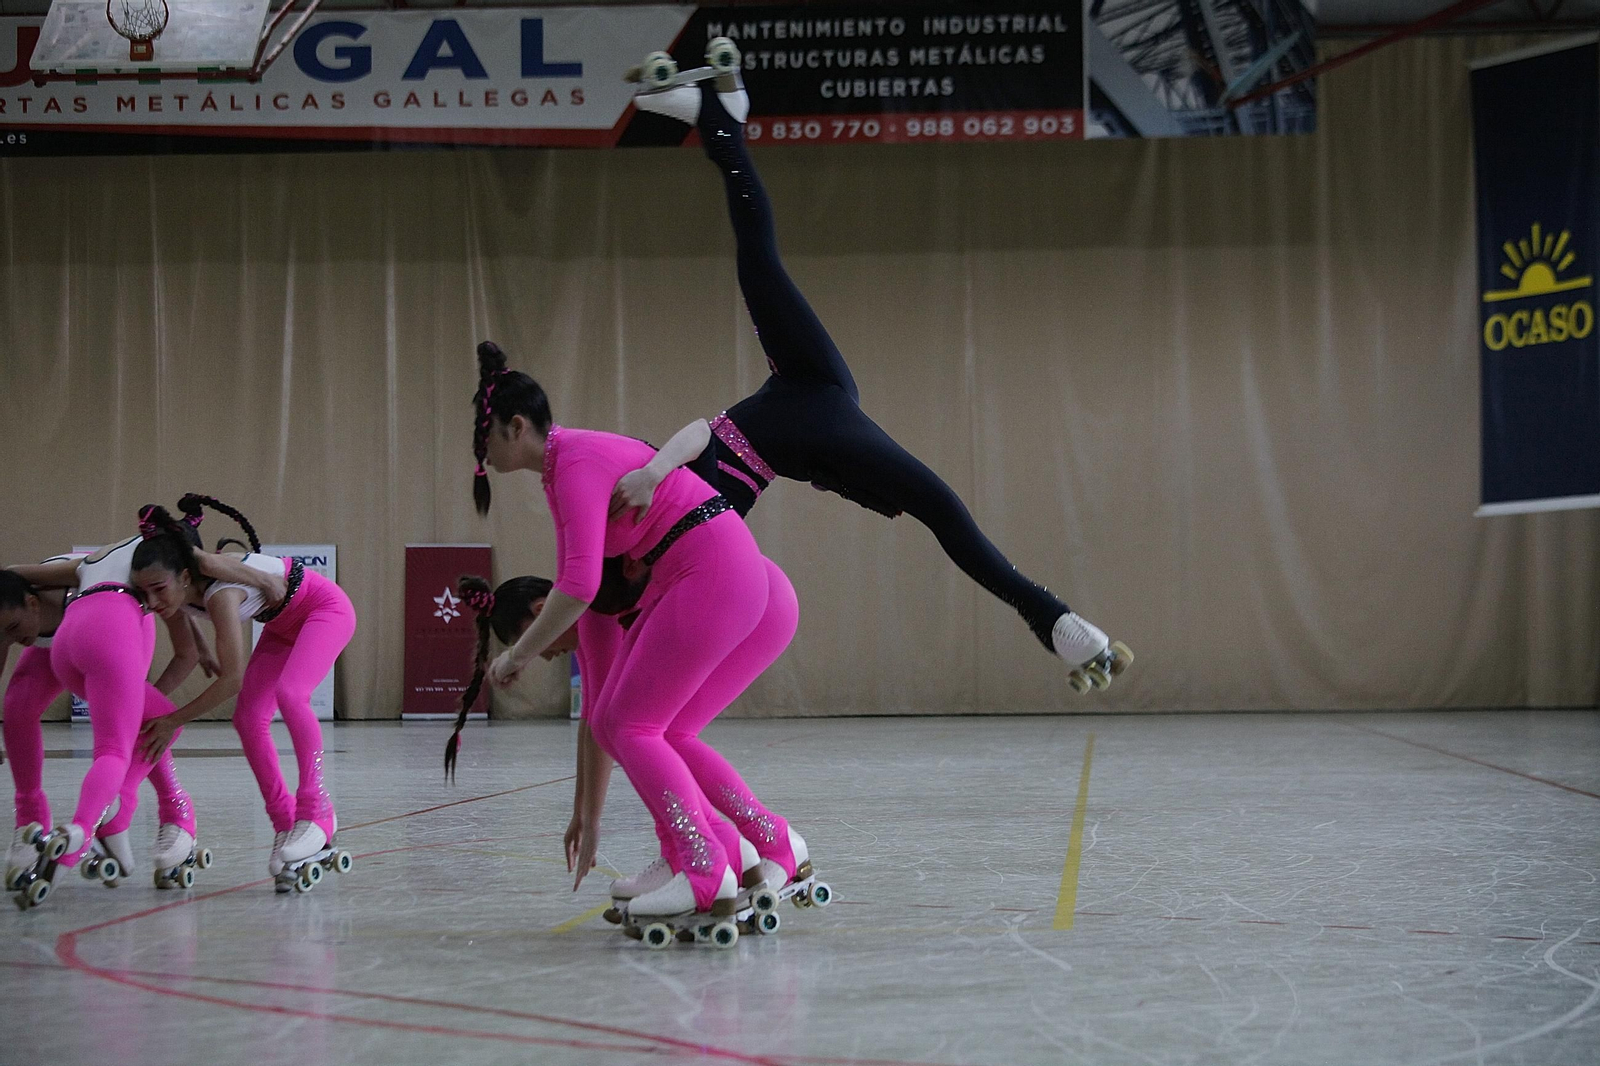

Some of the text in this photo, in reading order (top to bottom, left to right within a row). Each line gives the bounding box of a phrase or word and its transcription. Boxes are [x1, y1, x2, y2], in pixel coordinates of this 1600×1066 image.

[706, 14, 1067, 41] MANTENIMIENTO INDUSTRIAL
[745, 43, 1046, 70] STRUCTURAS METÁLICAS
[820, 77, 955, 99] CUBIERTAS
[116, 92, 346, 113] METÁLICAS
[374, 89, 585, 109] GALLEGAS
[772, 120, 821, 139] 830
[832, 119, 880, 138] 770
[906, 117, 954, 136] 988
[963, 116, 1012, 135] 062
[1023, 115, 1074, 134] 903
[1484, 302, 1594, 350] OCASO
